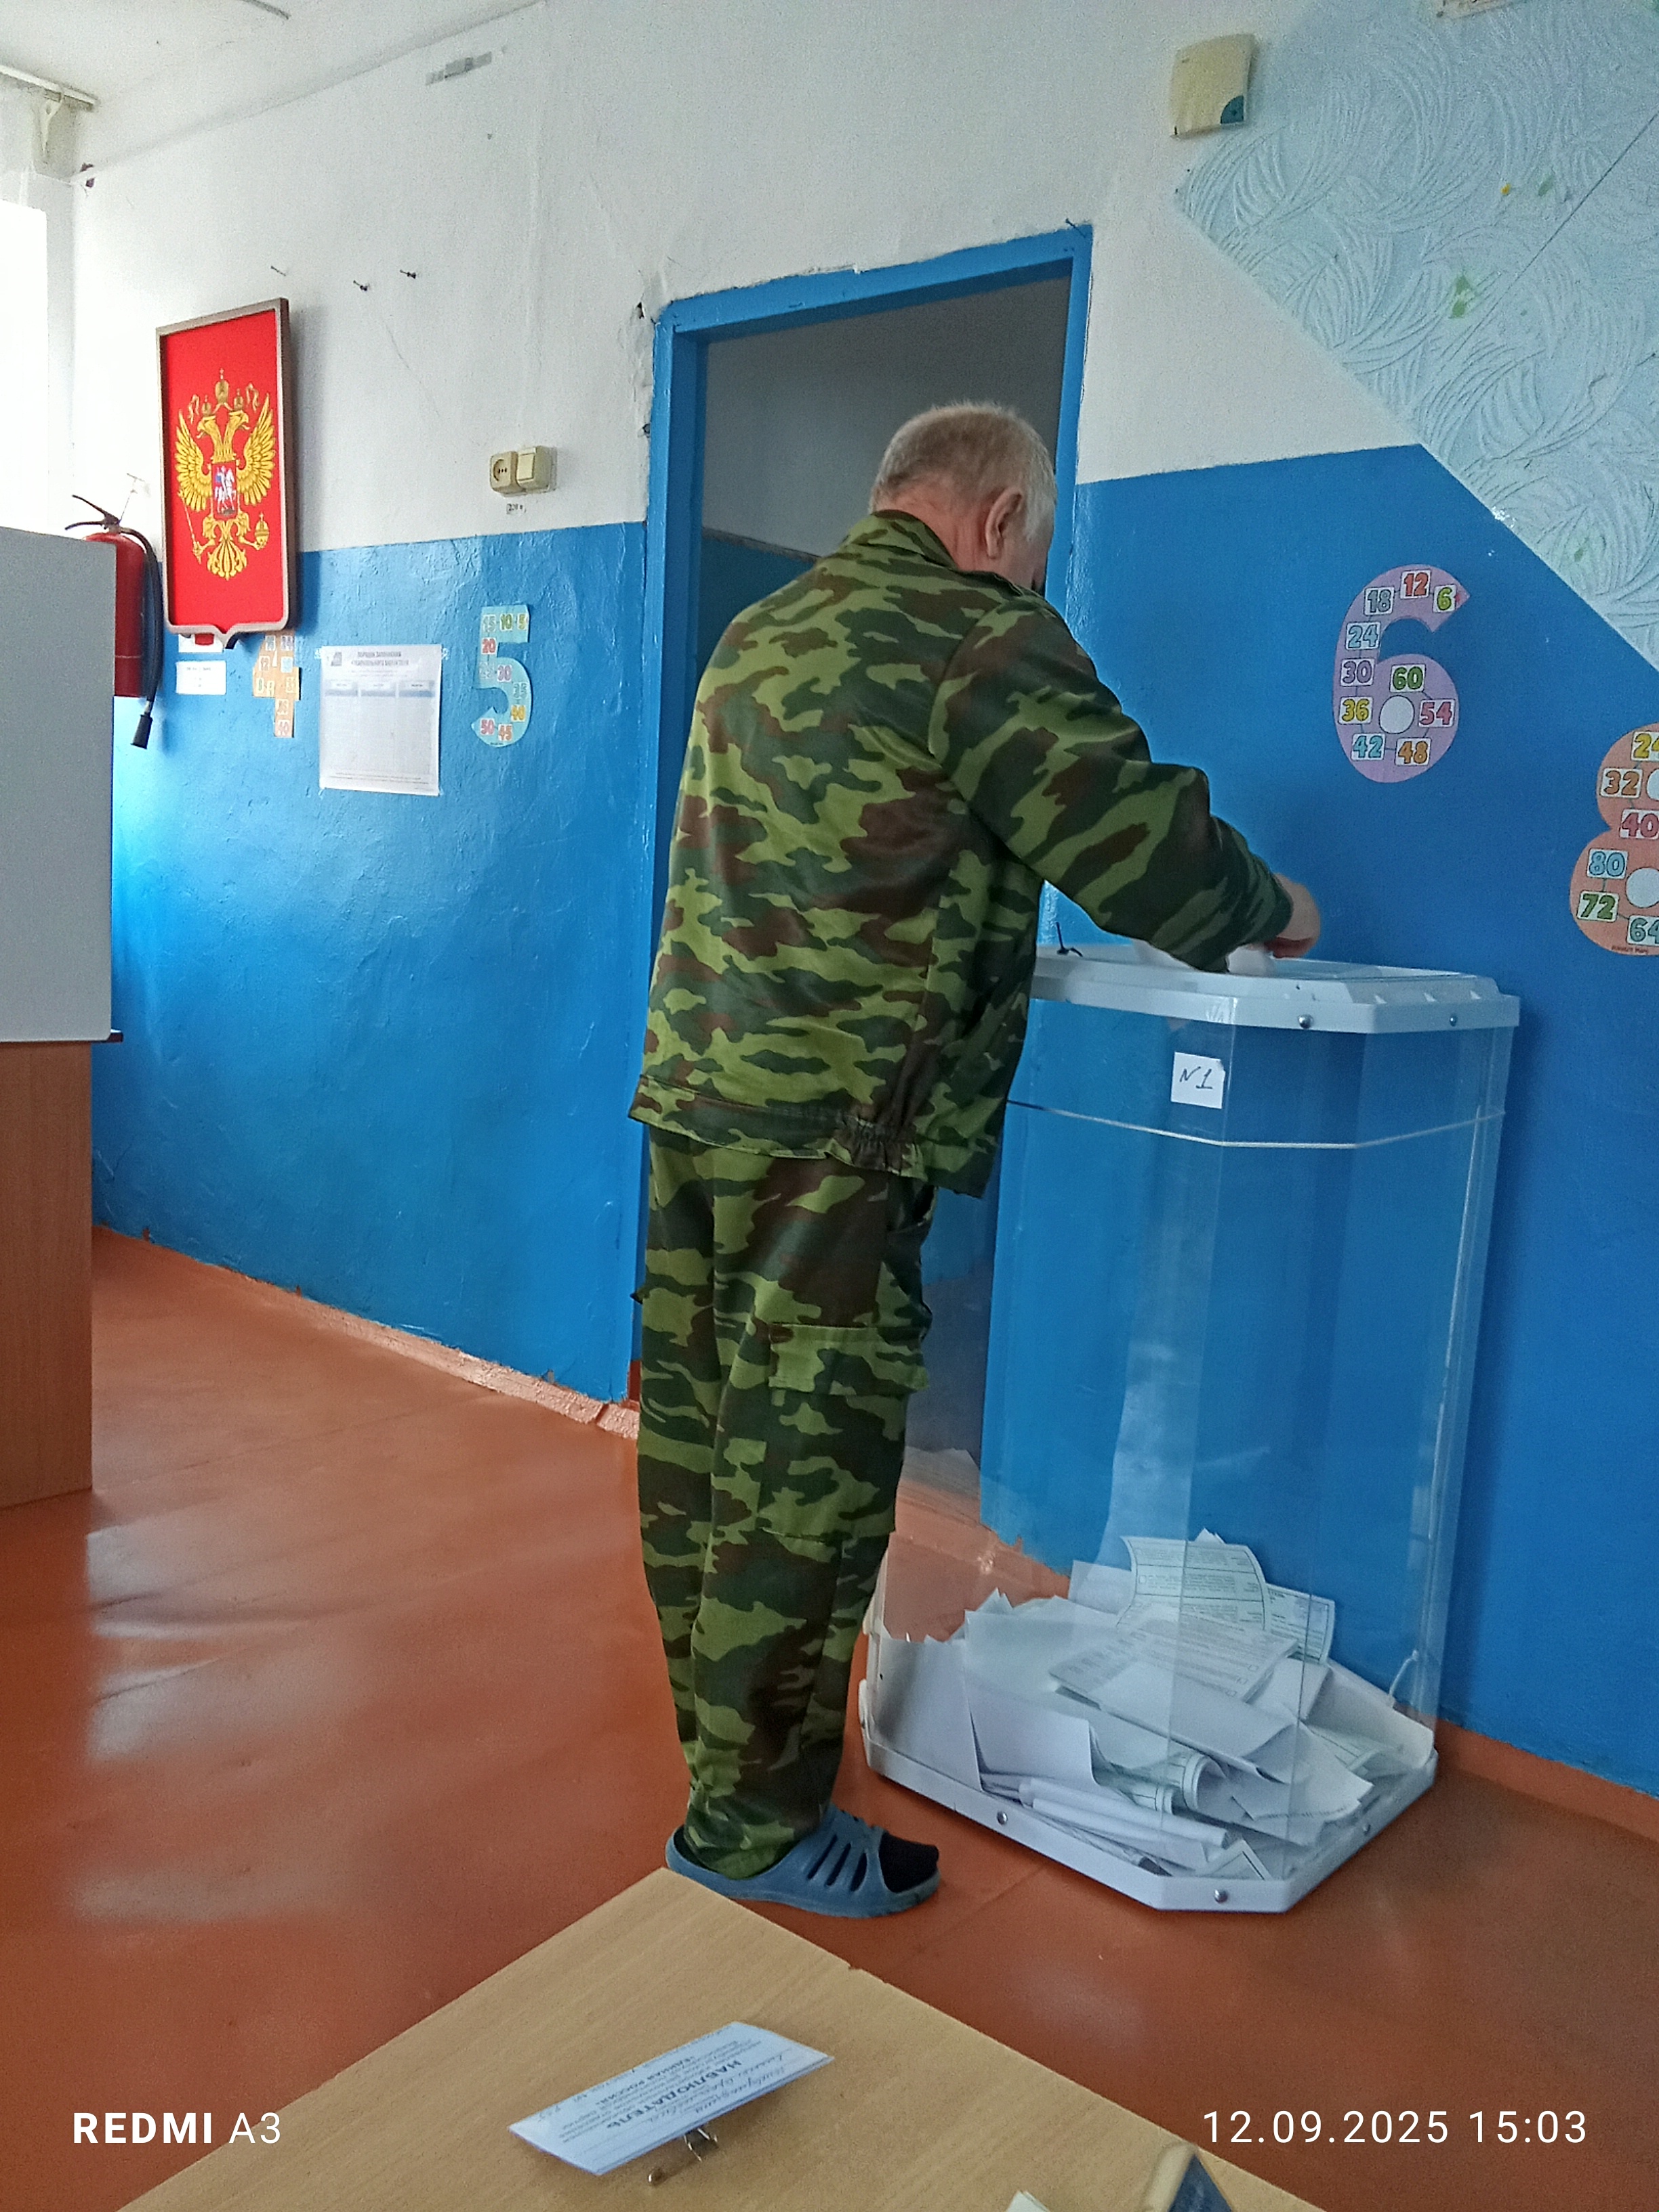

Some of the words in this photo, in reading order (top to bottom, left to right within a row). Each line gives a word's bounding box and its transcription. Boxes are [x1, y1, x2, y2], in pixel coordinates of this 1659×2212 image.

[1403, 573, 1429, 596] 12
[1367, 589, 1391, 613] 18
[1437, 586, 1452, 611] 6
[483, 616, 495, 632] 15
[500, 613, 513, 630] 10
[518, 614, 525, 630] 5
[482, 638, 496, 654] 20
[1348, 624, 1378, 649] 24
[497, 665, 512, 681] 30
[1343, 660, 1373, 684] 30
[1392, 666, 1424, 690] 60
[513, 682, 527, 699] 35
[512, 705, 525, 720] 40
[1342, 699, 1370, 722] 36
[1419, 701, 1452, 725] 54
[480, 719, 494, 735] 50
[498, 725, 512, 741] 45
[1353, 735, 1383, 758] 42
[1397, 741, 1428, 764] 48
[1603, 770, 1640, 796] 32
[1621, 813, 1659, 837] 40
[1589, 851, 1625, 877] 80
[1580, 894, 1616, 920] 72
[605, 2060, 742, 2129] НАБЛЮДАТЕЛЬ
